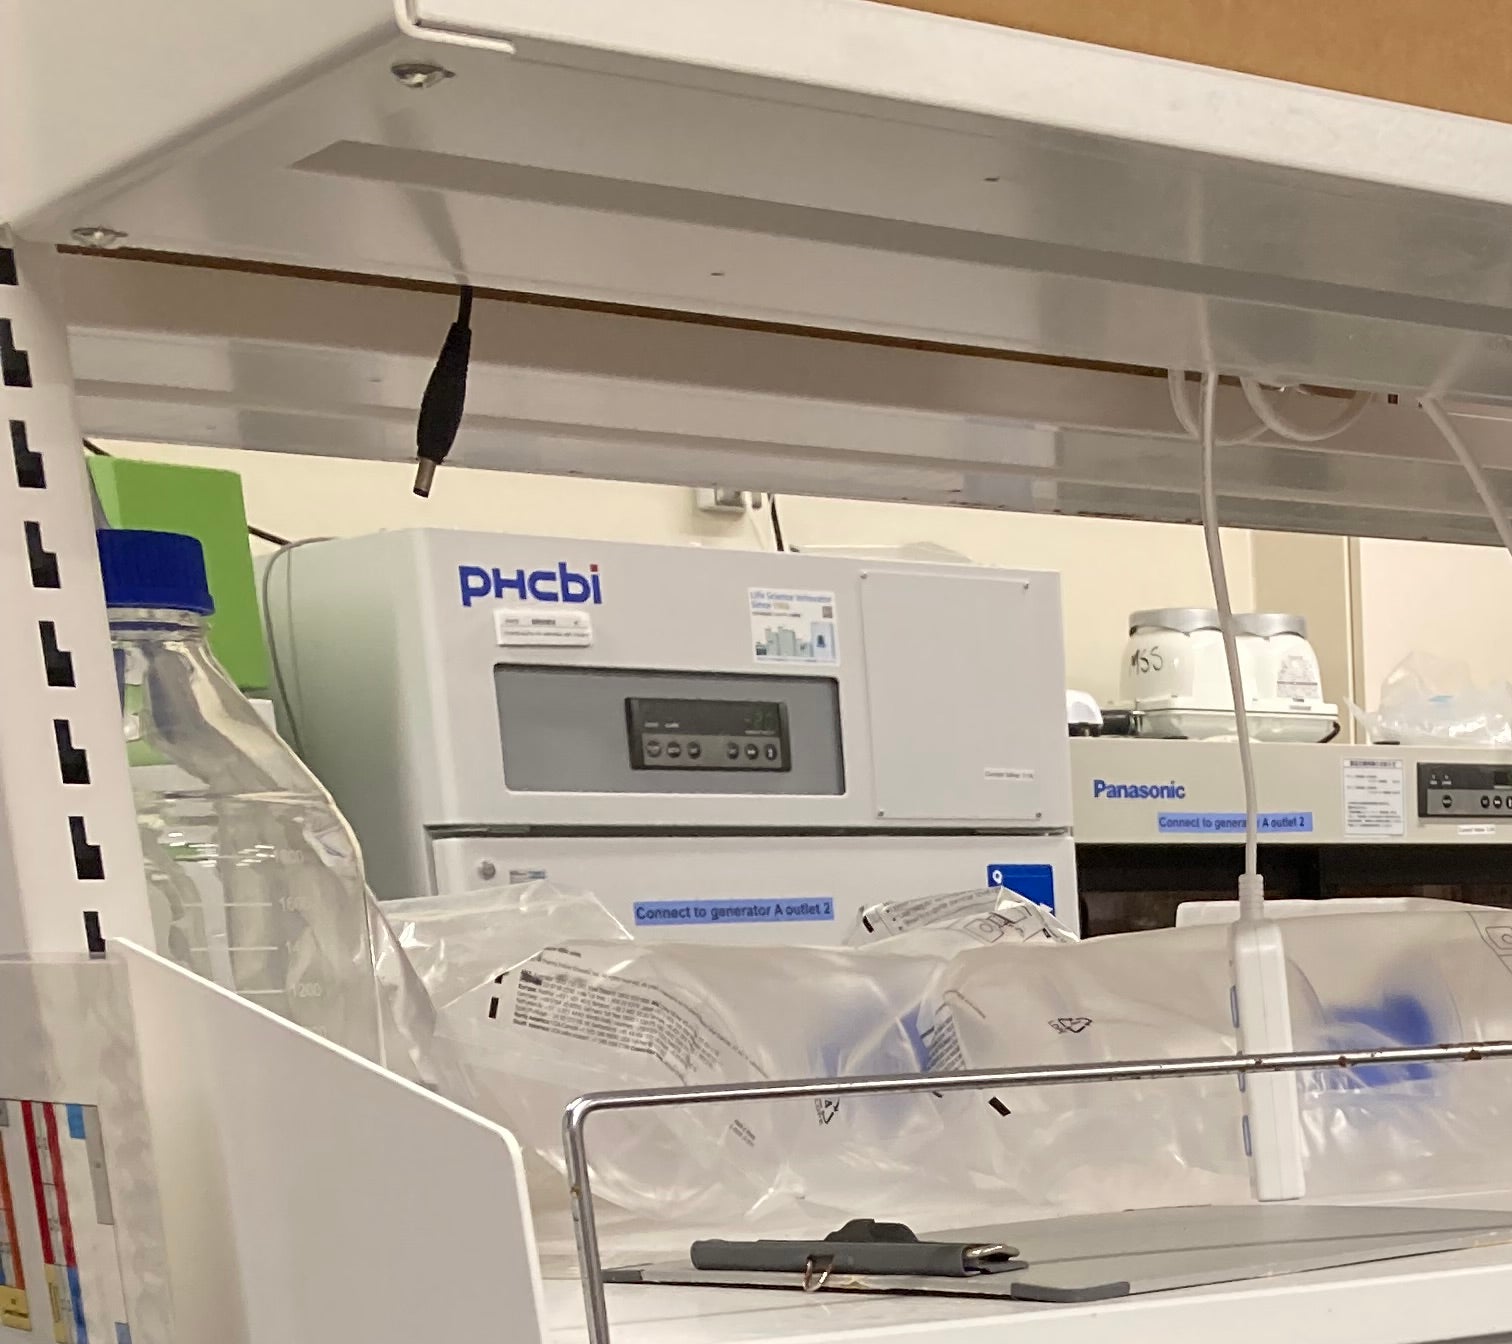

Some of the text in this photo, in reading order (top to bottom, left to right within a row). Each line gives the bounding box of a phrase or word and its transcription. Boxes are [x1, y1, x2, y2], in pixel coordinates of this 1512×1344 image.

[1093, 779, 1186, 800] Panasonic
[1158, 815, 1305, 831] Connect to genera A outlet 2
[636, 902, 831, 921] Connect to generator A outlet 2
